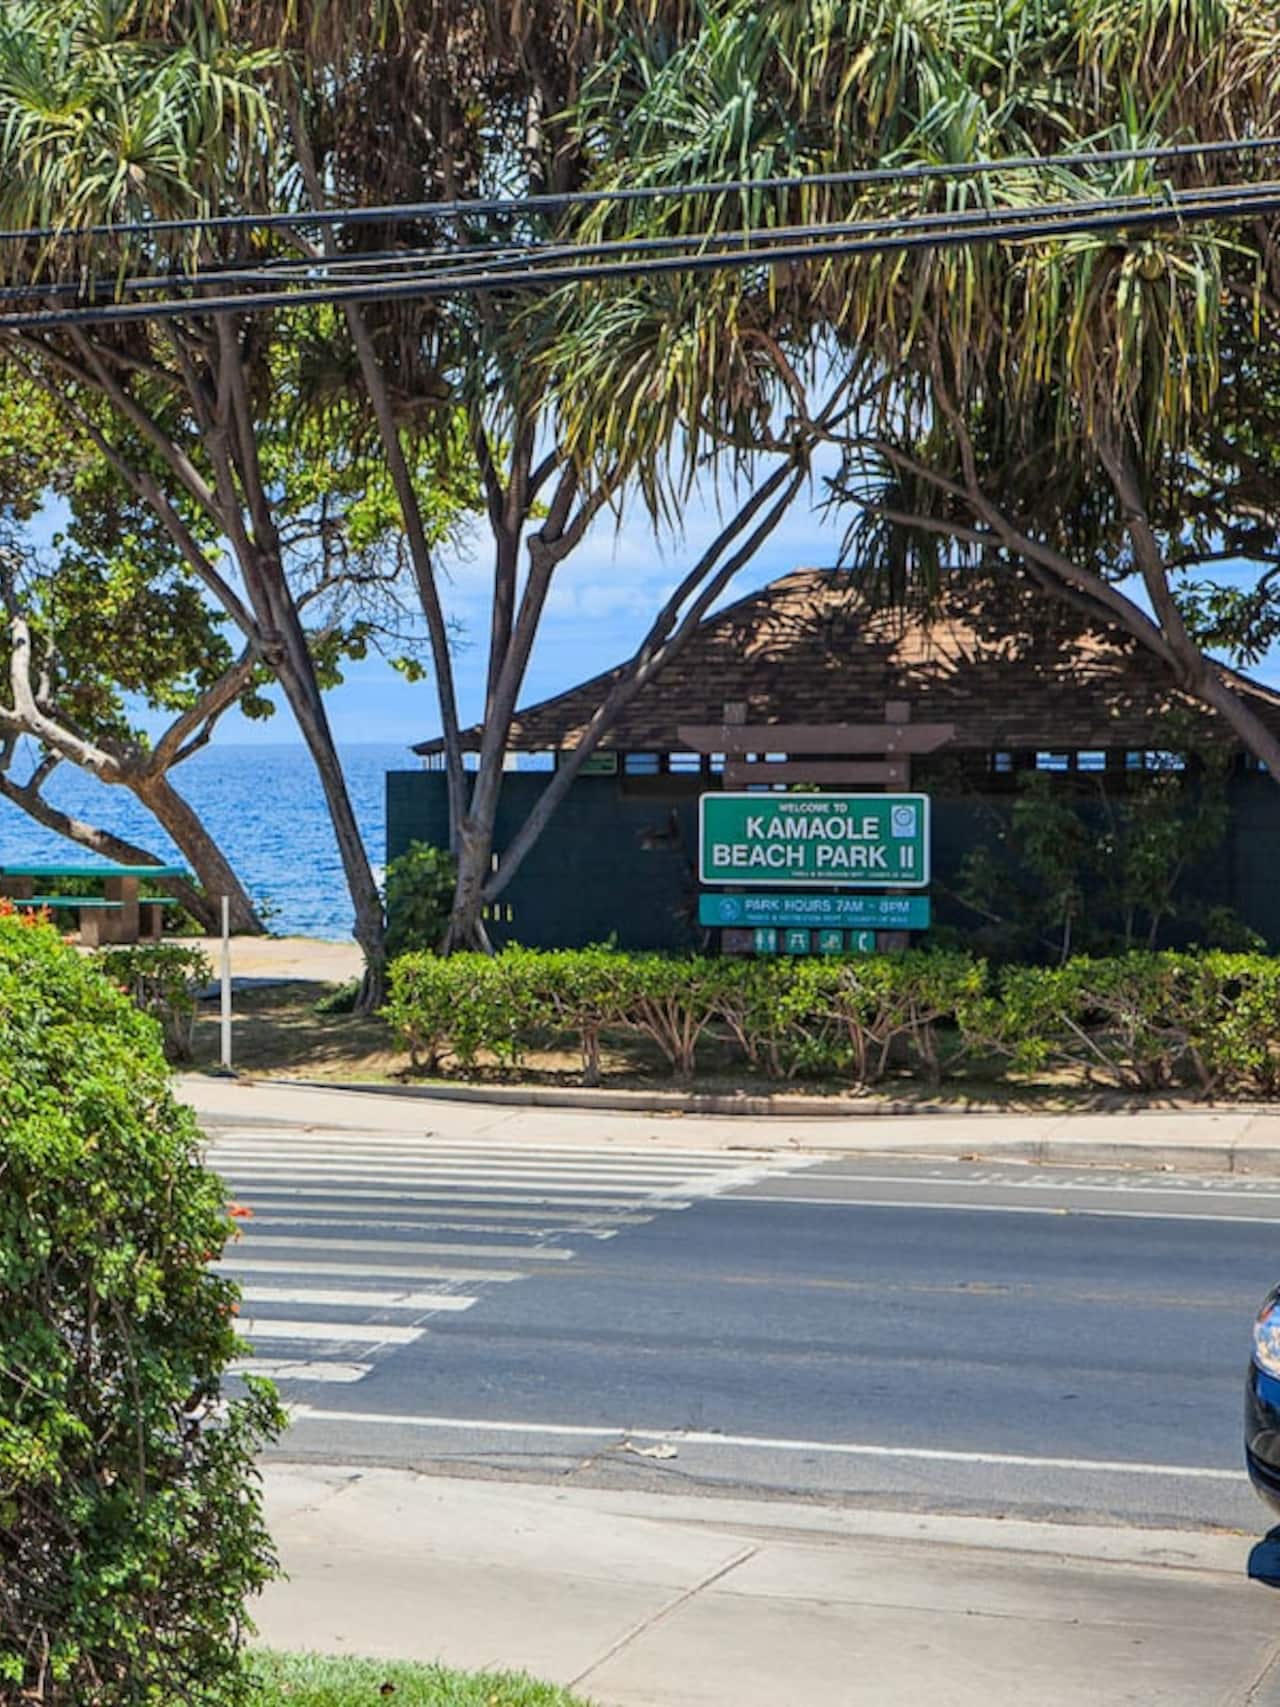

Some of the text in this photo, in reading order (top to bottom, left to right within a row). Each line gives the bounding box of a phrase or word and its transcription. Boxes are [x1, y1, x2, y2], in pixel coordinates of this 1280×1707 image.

[779, 803, 849, 814] WELCOME TO
[746, 816, 880, 840] KAMAOLE
[713, 844, 914, 868] BEACH PARK II
[744, 899, 781, 912] PARK
[784, 900, 832, 912] HOURS
[836, 900, 864, 912] 7AM
